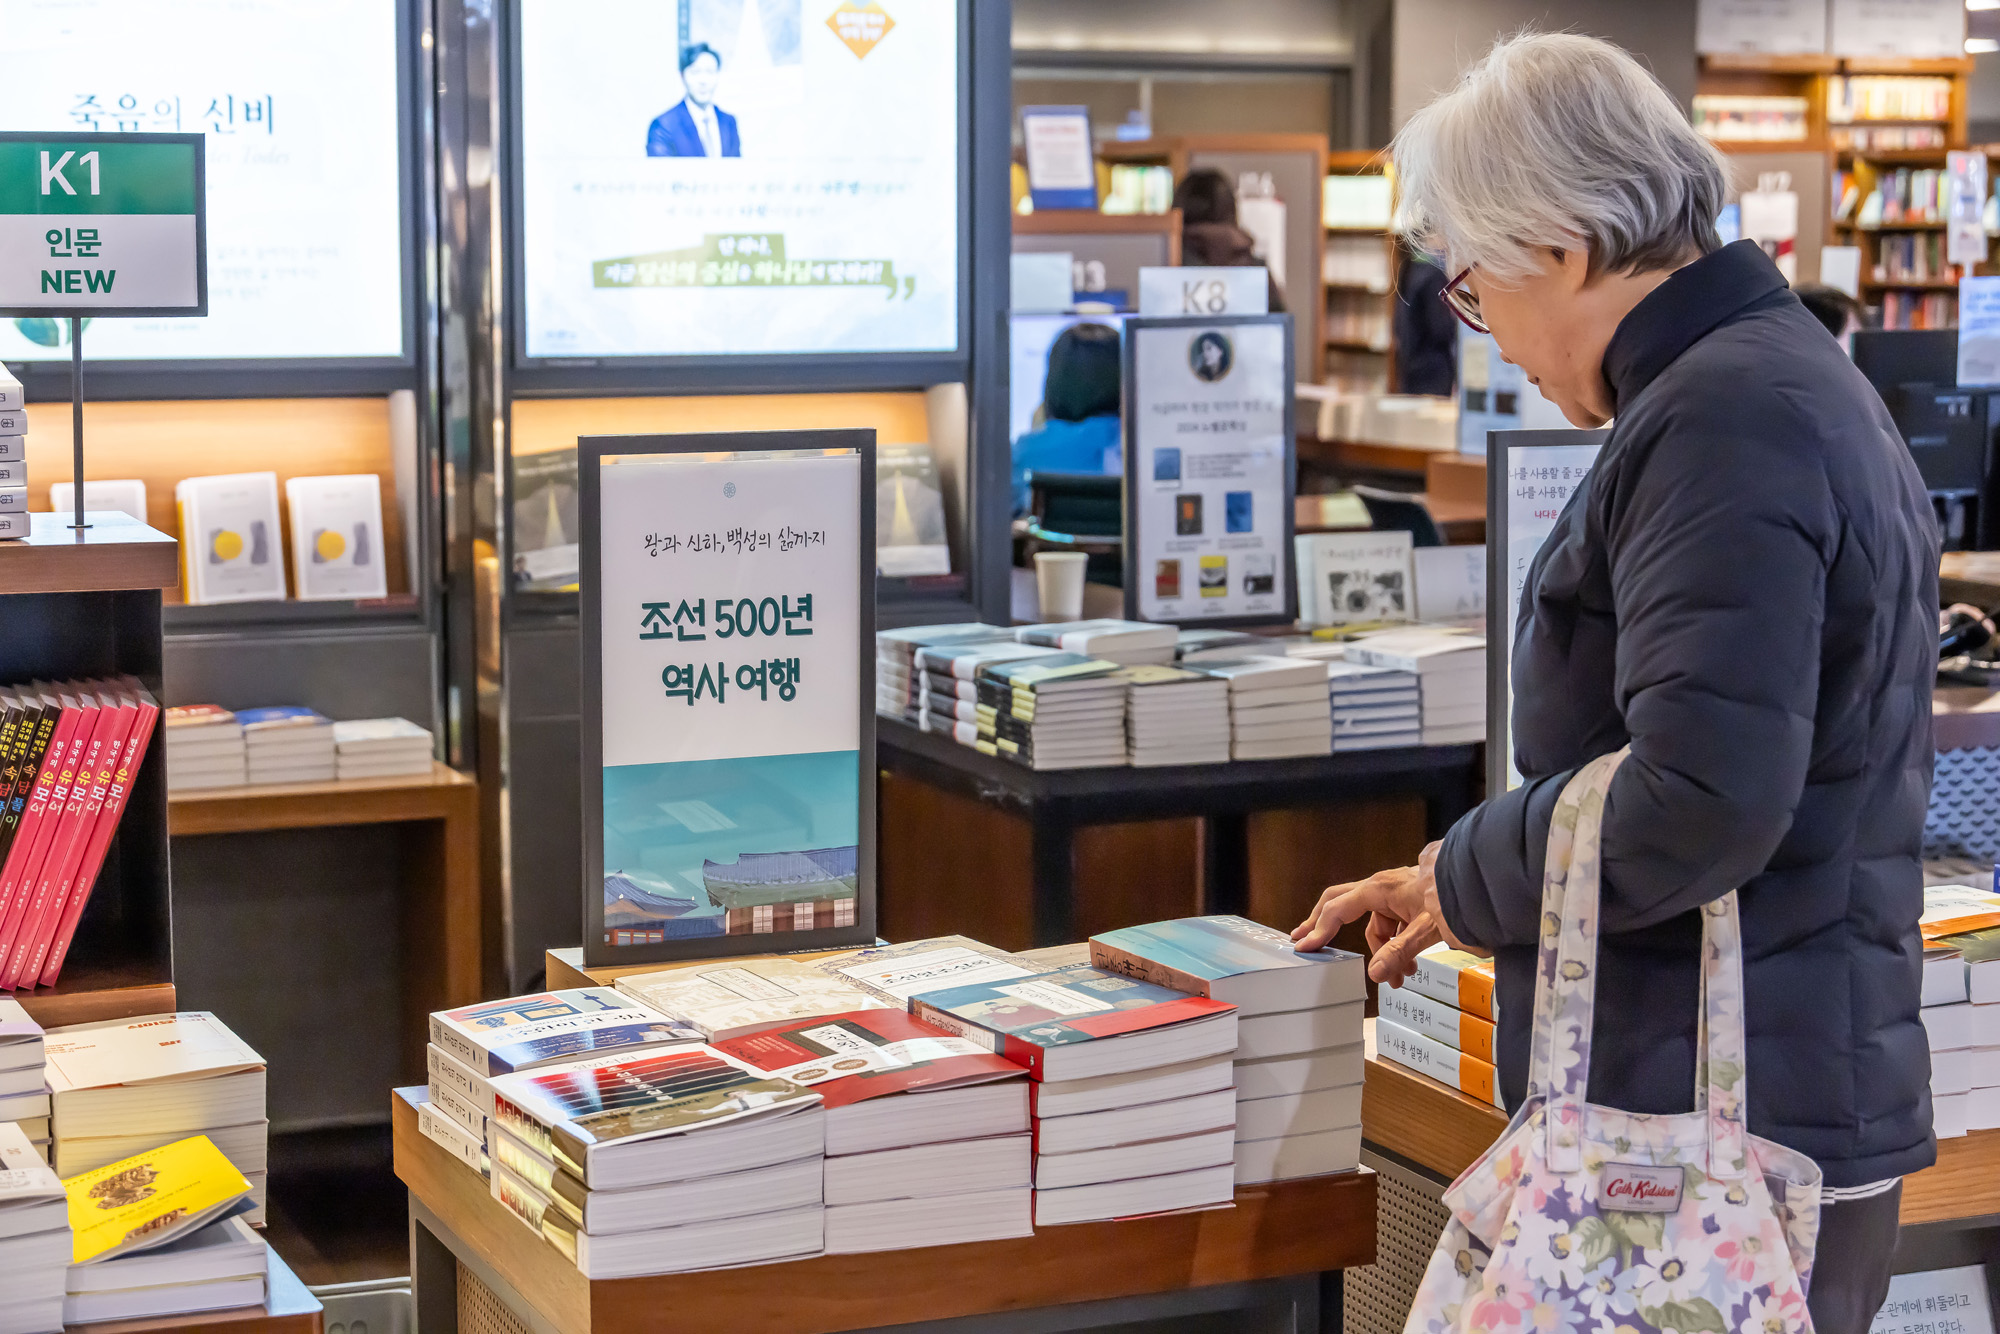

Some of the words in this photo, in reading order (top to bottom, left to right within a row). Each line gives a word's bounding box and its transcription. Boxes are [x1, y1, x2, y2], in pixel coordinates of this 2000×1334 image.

[69, 94, 181, 131] 죽음의
[203, 94, 273, 135] 신비
[41, 151, 100, 196] K1
[45, 227, 102, 258] 인문
[41, 269, 116, 294] NEW
[1183, 280, 1227, 313] K8
[1509, 467, 1528, 480] 나를
[1530, 466, 1559, 480] 사용할
[1562, 466, 1572, 480] 줄
[1516, 486, 1536, 500] 나를
[1538, 486, 1567, 499] 사용할
[1534, 510, 1558, 520] 나다운
[645, 533, 681, 557] 왕과
[778, 526, 826, 552] 삶까지
[639, 599, 706, 641] 조선
[715, 593, 813, 639] 500년
[661, 661, 729, 706] 역사
[736, 657, 801, 702] 여행
[50, 741, 64, 768] 한국의
[68, 739, 83, 766] 한국의
[87, 740, 102, 768] 한국의
[106, 740, 122, 768] 한국의
[124, 738, 138, 765] 한국의
[30, 770, 54, 818] 유모어
[48, 770, 72, 816] 유모어
[66, 770, 91, 816] 유모어
[87, 770, 110, 816] 유모어
[104, 768, 128, 814] 유모어
[1386, 996, 1392, 1011] 나
[1395, 1000, 1408, 1018] 사용
[1412, 1006, 1432, 1027] 설명서
[1384, 1034, 1390, 1048] 나
[1393, 1038, 1406, 1056] 사용
[1409, 1044, 1430, 1065] 설명서
[1606, 1178, 1632, 1198] Cath
[1632, 1180, 1676, 1200] Kidston
[1887, 1299, 1922, 1317] 관계에
[1925, 1293, 1971, 1312] 휘둘리고
